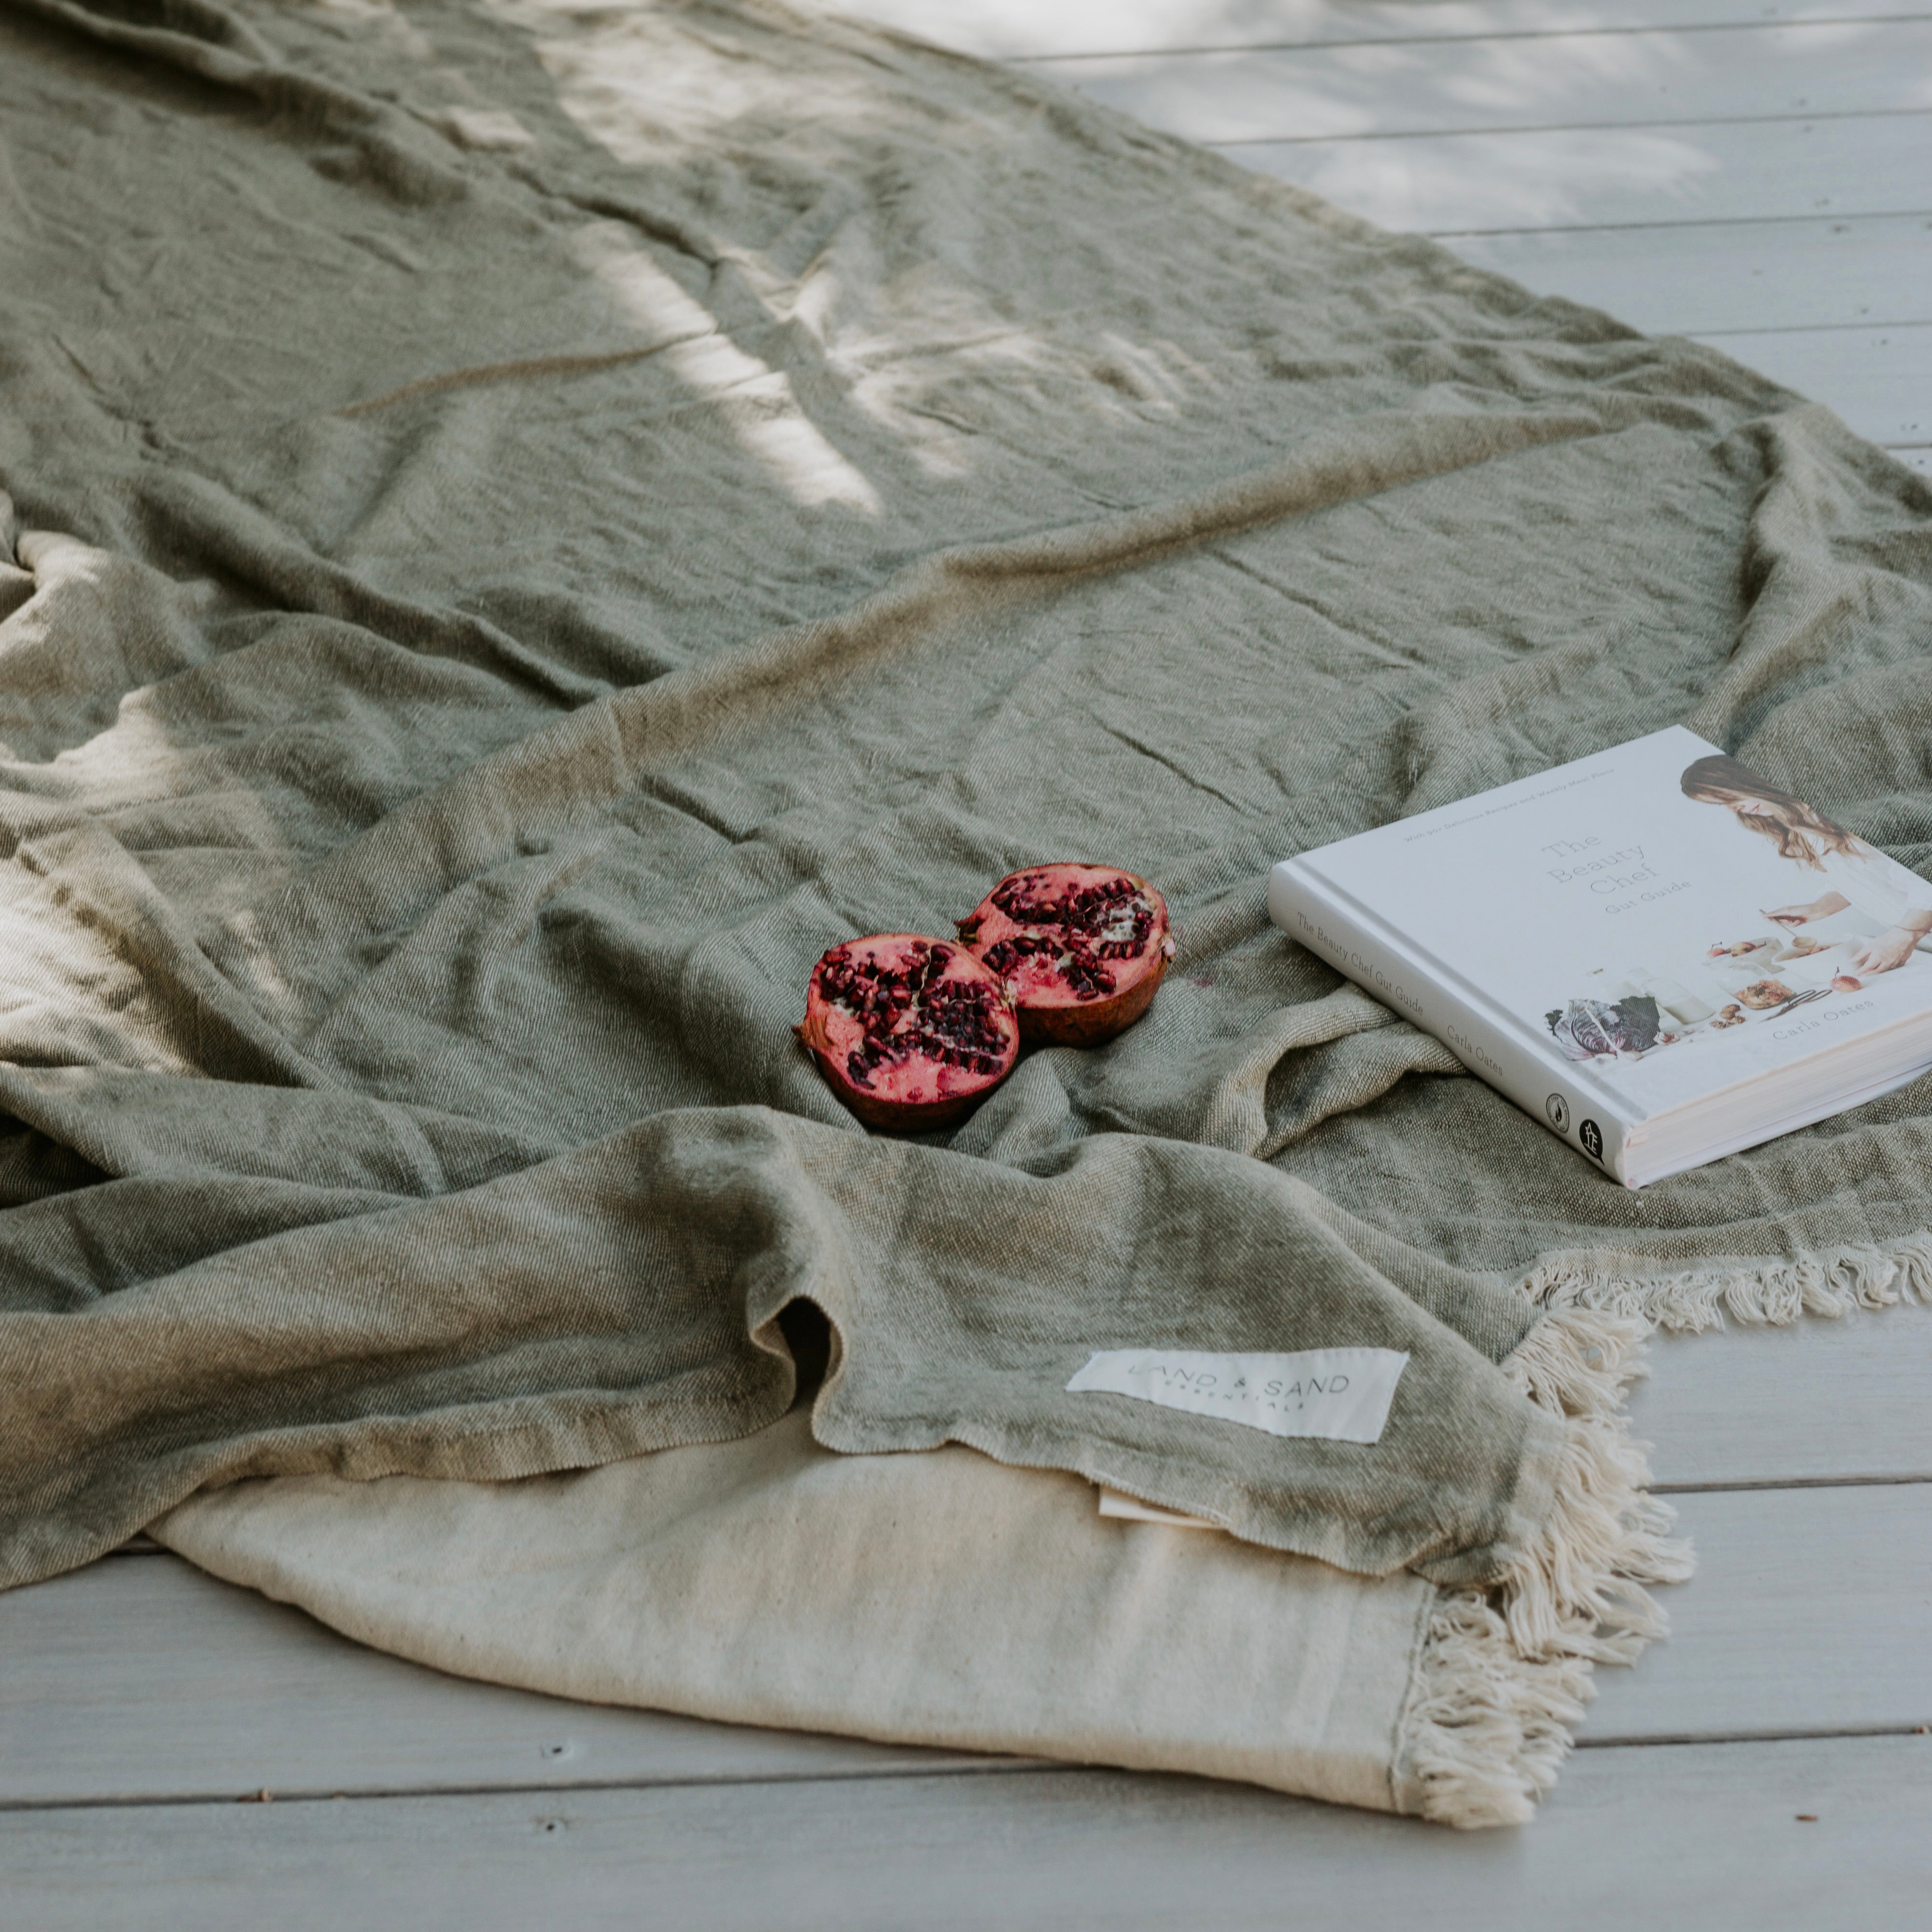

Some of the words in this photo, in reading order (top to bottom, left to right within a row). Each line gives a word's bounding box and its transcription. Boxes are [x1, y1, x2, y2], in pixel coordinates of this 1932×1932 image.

[1541, 836, 1602, 858] The
[1546, 844, 1645, 884] Beauty
[1590, 862, 1659, 895] Chef
[1605, 899, 1638, 914] Gut
[1640, 881, 1691, 901] Guide
[1297, 911, 1314, 935] The
[1317, 926, 1348, 961] Beauty
[1351, 952, 1373, 978] Chef
[1376, 970, 1392, 993] Gut
[1395, 985, 1423, 1016] Guide
[1773, 1020, 1822, 1040] Carla
[1823, 999, 1874, 1021] Oates
[1447, 1024, 1472, 1053] Carla
[1476, 1046, 1504, 1077] Oates
[1128, 1365, 1217, 1387] LAND
[1234, 1377, 1246, 1389] &
[1264, 1375, 1350, 1398] SAND
